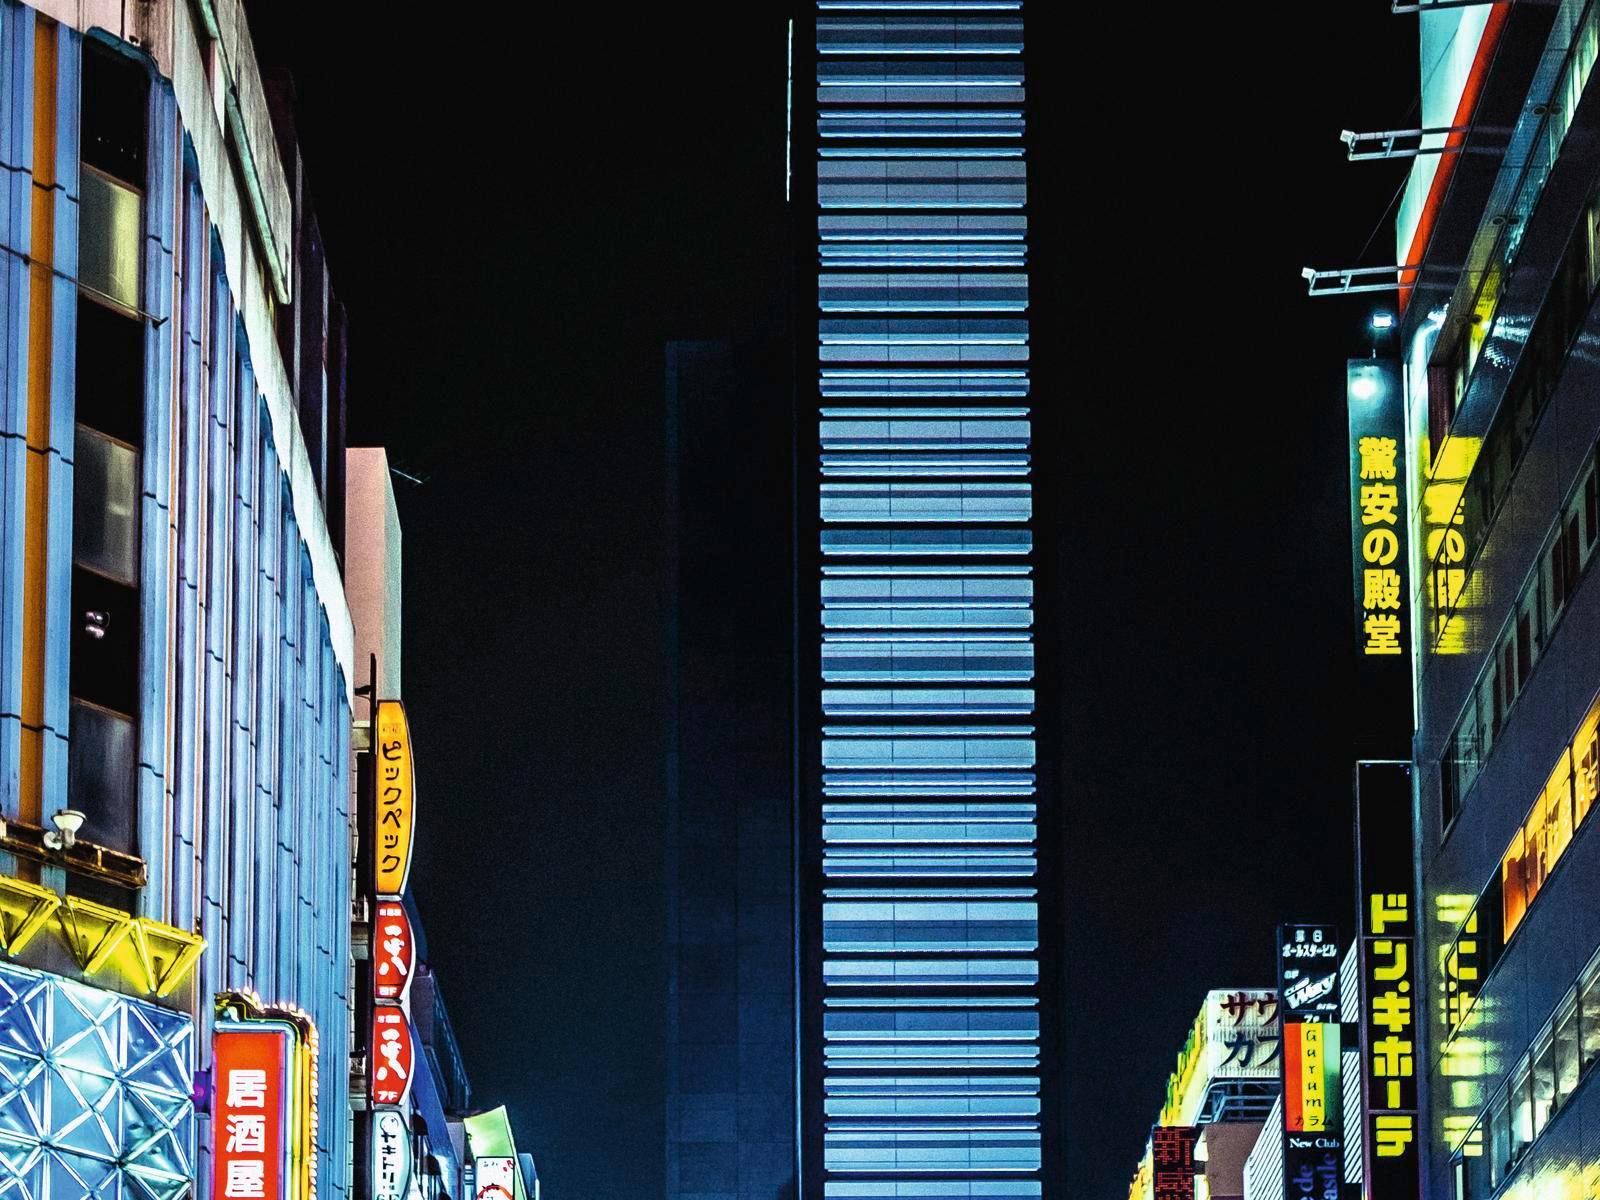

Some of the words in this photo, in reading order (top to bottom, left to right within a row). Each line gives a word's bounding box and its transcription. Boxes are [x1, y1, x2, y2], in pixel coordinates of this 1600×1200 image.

[1358, 436, 1402, 654] 驚安の殿堂
[378, 1091, 398, 1101] 7F
[225, 1069, 268, 1199] 居酒屋
[1289, 1138, 1312, 1148] New
[1315, 1138, 1340, 1148] Club
